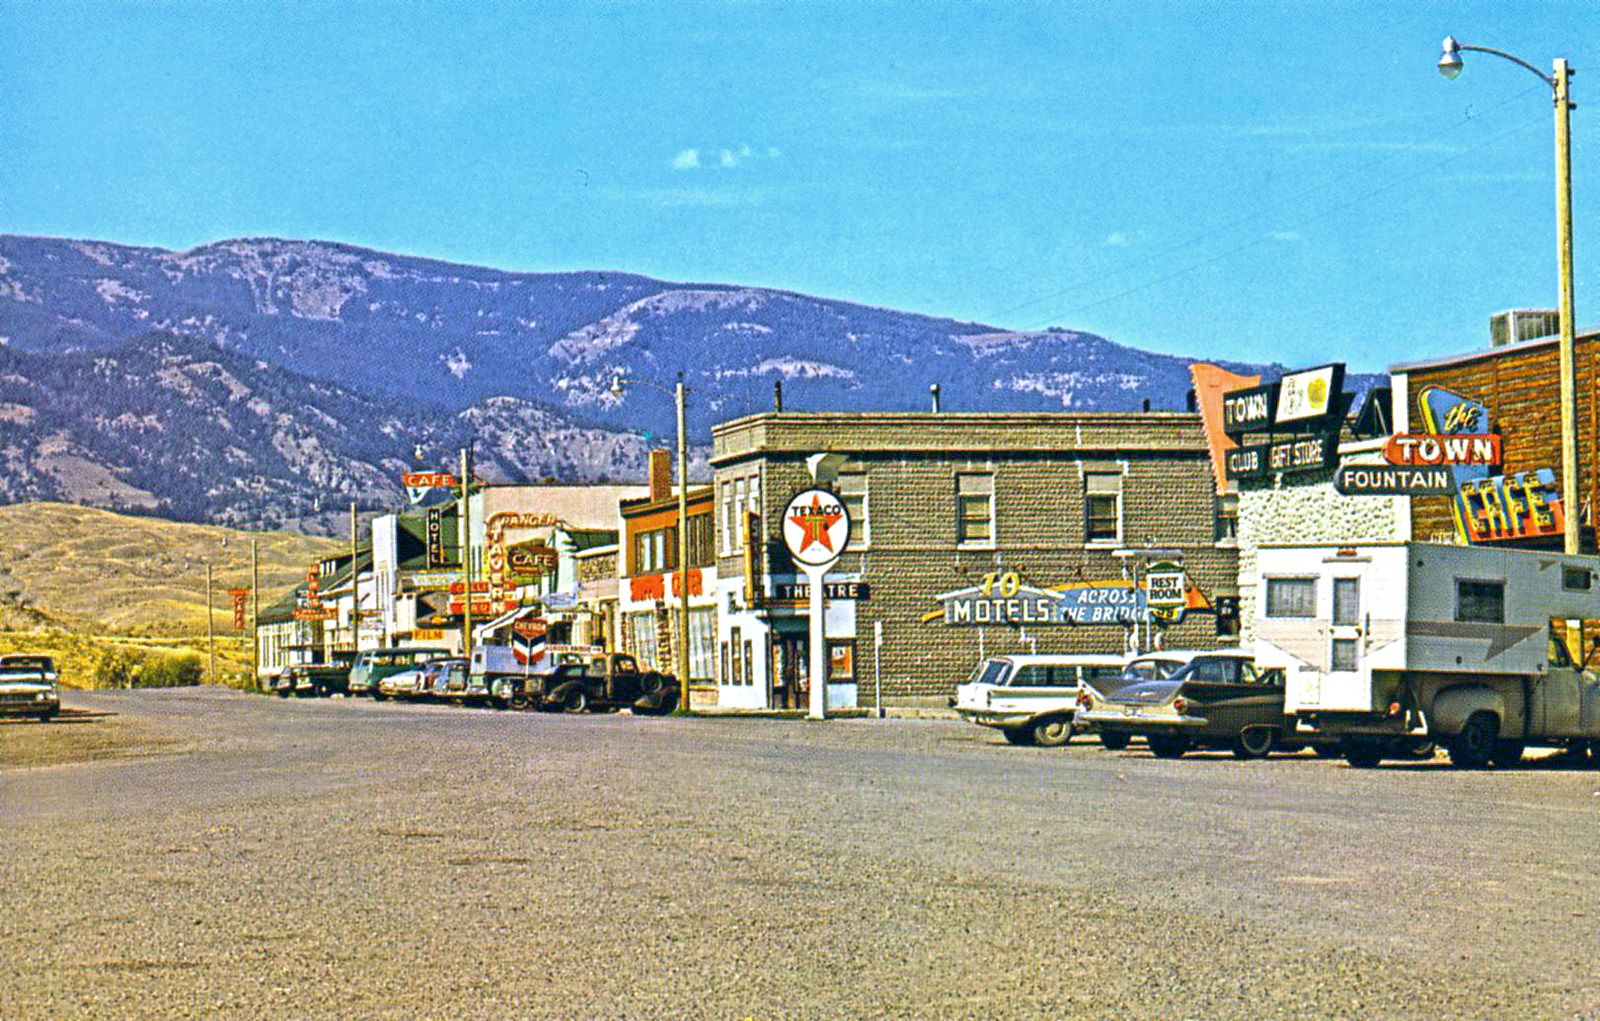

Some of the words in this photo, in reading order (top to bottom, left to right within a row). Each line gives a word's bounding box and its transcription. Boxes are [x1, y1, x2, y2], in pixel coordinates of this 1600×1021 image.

[1226, 392, 1269, 424] TOWN
[1231, 450, 1259, 472] CLUB
[1269, 443, 1292, 469] GIFT
[1293, 439, 1325, 466] STORE
[1395, 437, 1492, 462] TOWN
[406, 476, 452, 486] CAFE
[1343, 470, 1448, 489] FOUNTAIN
[791, 505, 842, 517] TEXACO
[1460, 472, 1556, 538] CAFE
[430, 512, 441, 564] HOTEL
[512, 553, 554, 567] CAFE
[490, 528, 504, 614] TAVERN
[981, 572, 1020, 598] 10
[1150, 577, 1179, 588] REST
[784, 585, 859, 599] THETRE
[1077, 588, 1137, 604] ACROSS
[1149, 588, 1182, 600] ROOM
[953, 599, 1049, 623] MOTELS
[1060, 606, 1087, 621] THE
[413, 629, 443, 641] FILM
